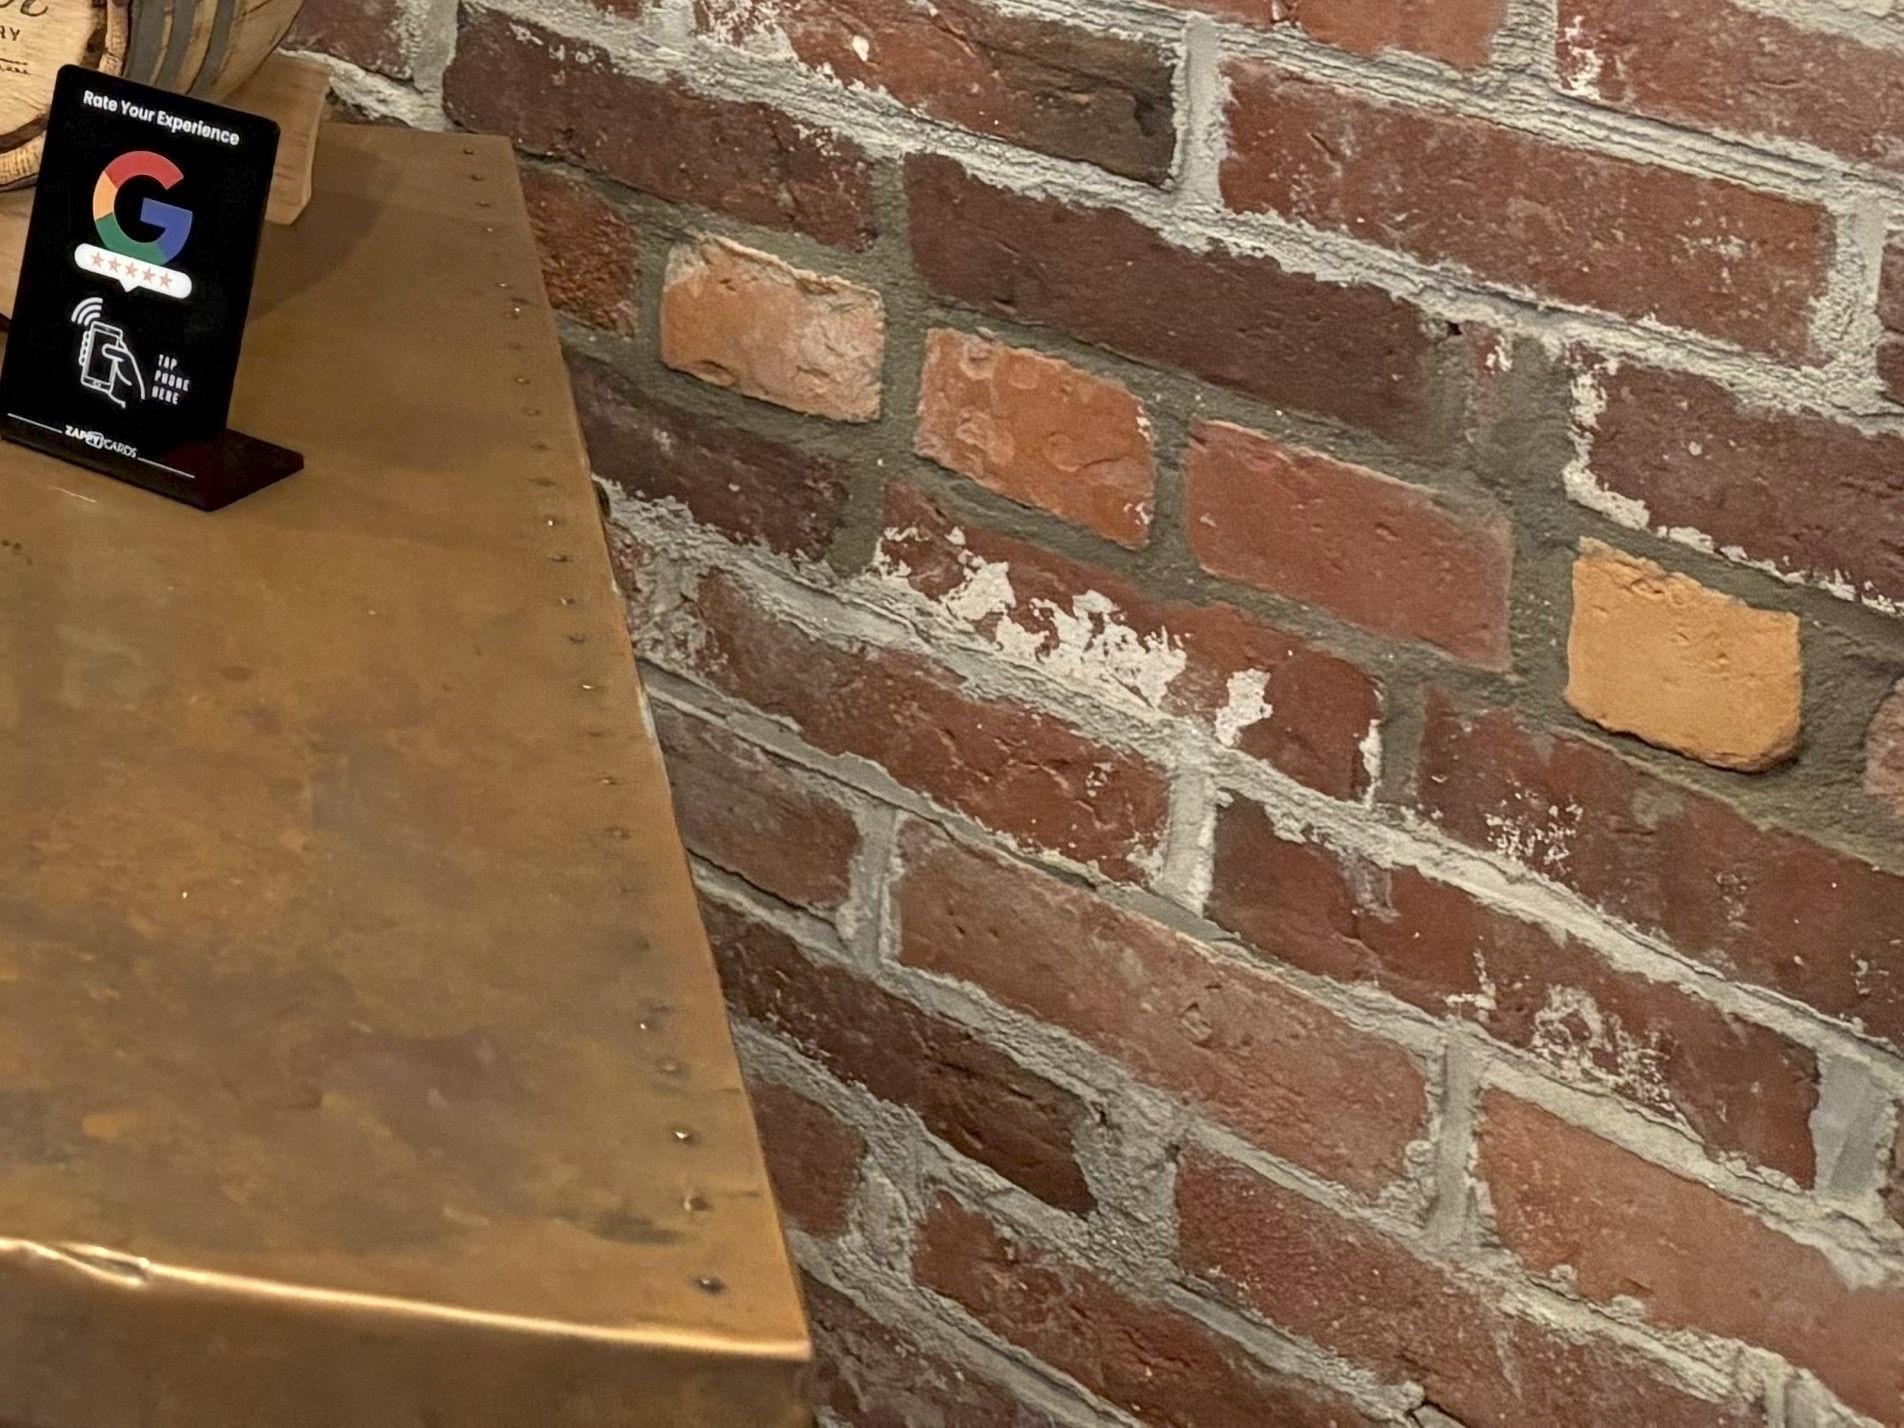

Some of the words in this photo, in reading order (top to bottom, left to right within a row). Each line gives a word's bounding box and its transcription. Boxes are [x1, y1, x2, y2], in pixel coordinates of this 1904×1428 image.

[82, 89, 119, 113] Rate
[120, 99, 156, 123] Your
[156, 109, 241, 147] Experience
[92, 150, 194, 266] G
[157, 353, 178, 371] TAP
[153, 369, 190, 392] PHONE
[151, 385, 180, 406] HERE
